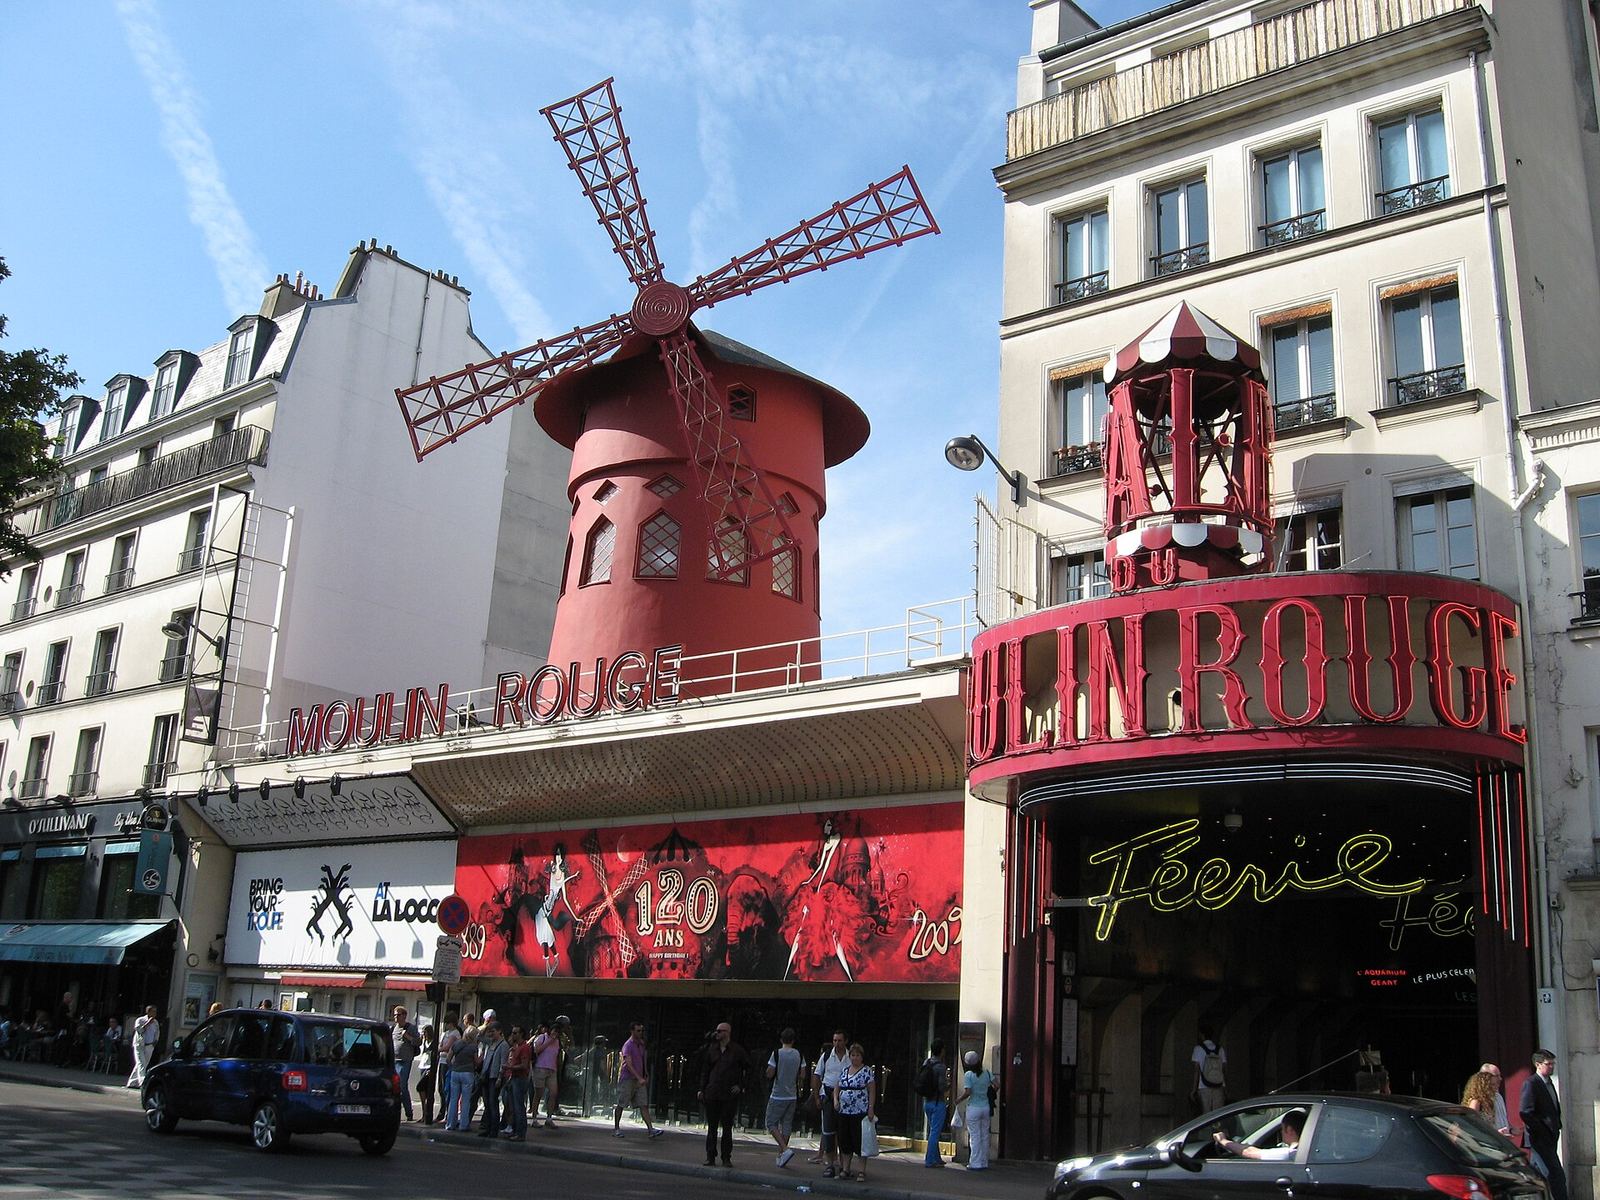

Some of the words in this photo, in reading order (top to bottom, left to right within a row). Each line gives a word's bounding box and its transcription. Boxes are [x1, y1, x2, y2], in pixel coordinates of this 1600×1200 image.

[1110, 549, 1179, 593] DU
[1177, 594, 1528, 745] ROUGE
[286, 683, 449, 759] MOULIN
[493, 644, 683, 728] ROUGE
[249, 878, 284, 896] BRING
[375, 882, 391, 899] AT
[1088, 818, 1427, 941] Féerie
[249, 896, 276, 913] YOUR
[372, 899, 392, 922] LA
[634, 869, 719, 936] 120
[247, 911, 284, 931] TROUPE
[909, 906, 963, 959] 2009
[653, 928, 685, 948] ANS
[1425, 970, 1449, 982] PLUS
